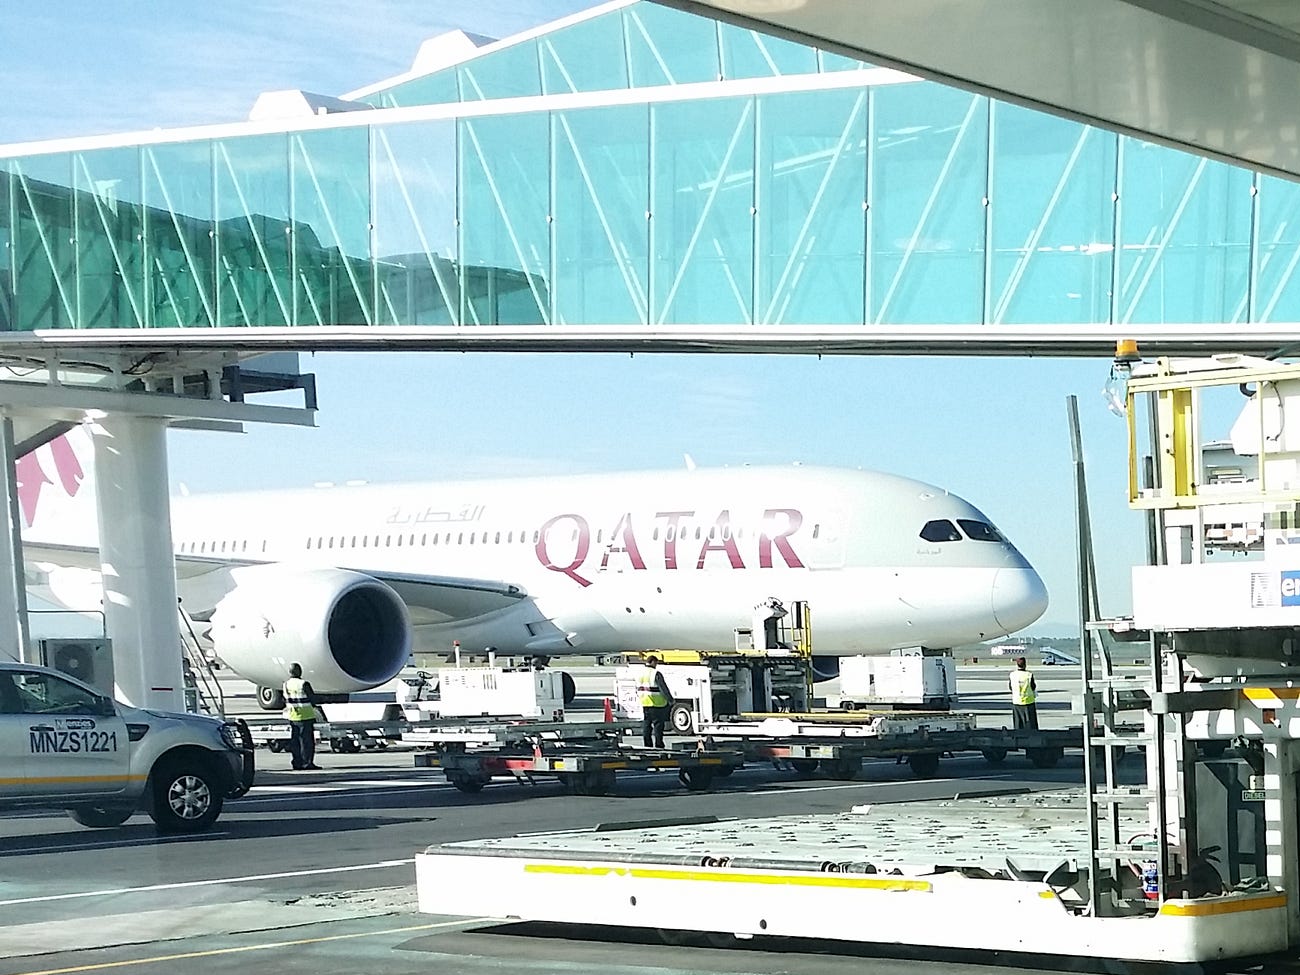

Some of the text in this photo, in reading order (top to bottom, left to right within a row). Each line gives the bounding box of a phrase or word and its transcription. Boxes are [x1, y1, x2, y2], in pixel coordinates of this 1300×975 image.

[386, 504, 486, 527] القطرية
[535, 508, 805, 587] QATAR
[30, 732, 117, 753] MNZS1221
